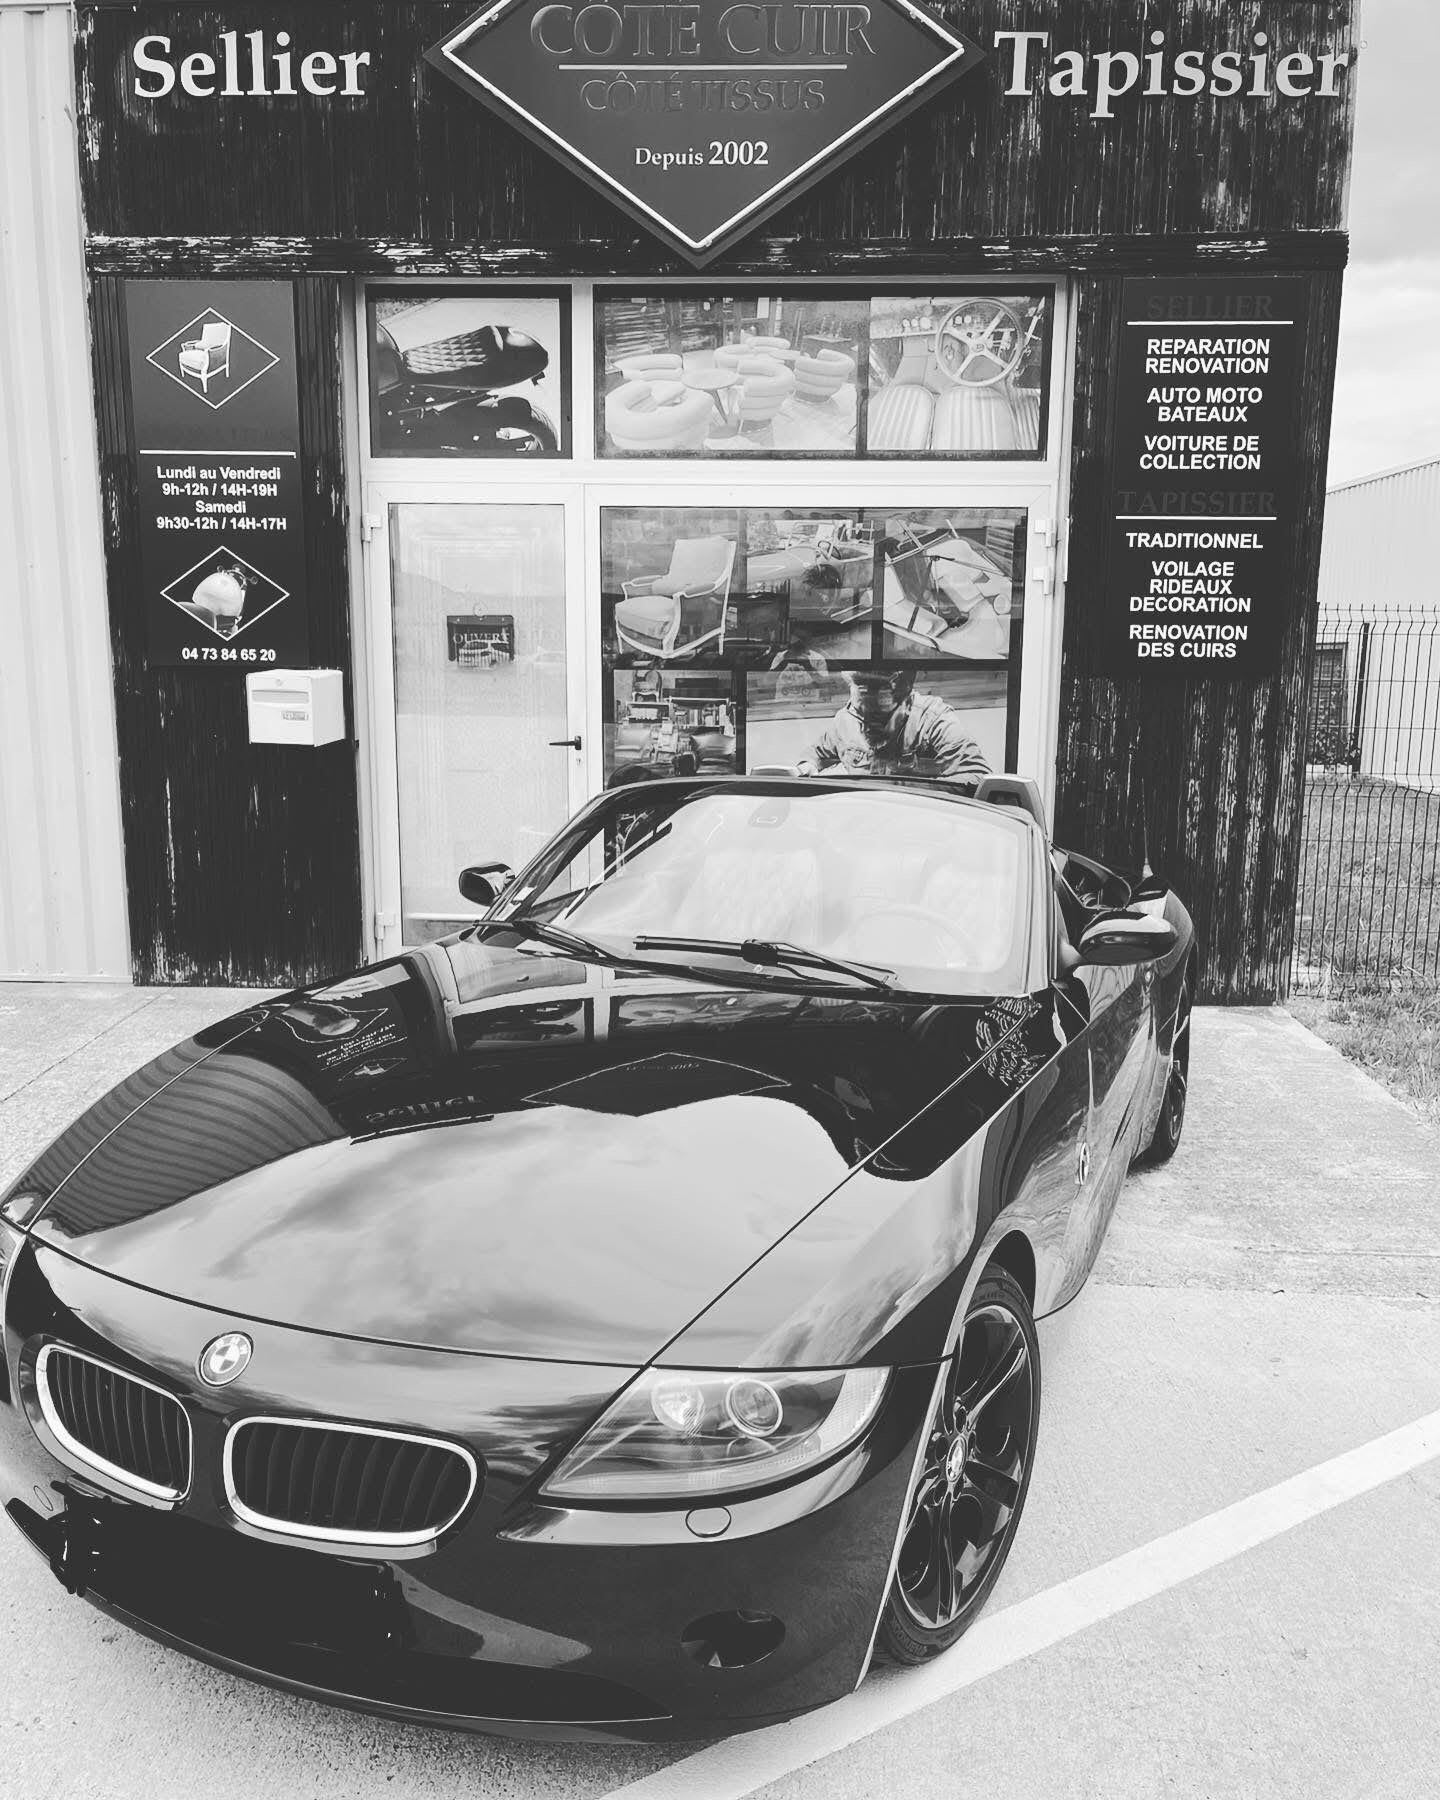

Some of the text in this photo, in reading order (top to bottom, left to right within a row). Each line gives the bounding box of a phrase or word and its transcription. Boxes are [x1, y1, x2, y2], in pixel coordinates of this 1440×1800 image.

[718, 4, 878, 56] CUIR
[132, 29, 371, 98] Sellier
[993, 30, 1348, 118] Tapissier
[580, 71, 825, 112] CÔTÉ TISSUS
[635, 141, 769, 170] Depuis 2002
[1146, 295, 1273, 319] SELLIER
[1146, 338, 1271, 355] REPARATION
[1145, 357, 1270, 374] RENOVATION
[1146, 387, 1263, 404] AUTO MOTO
[1157, 406, 1249, 422] BATEAUX
[1144, 435, 1260, 452] VOITURE DE
[1139, 453, 1262, 470] COLLECTION
[156, 465, 281, 480] Lundi au Vendredi
[161, 483, 209, 496] 9h-12h
[220, 483, 278, 497] 14H-19H
[195, 500, 247, 514] Samedi
[1116, 490, 1276, 514] TAPISSIER
[156, 516, 219, 530] 9h30-12h
[229, 517, 287, 531] 14H-17H
[1125, 532, 1264, 549] TRADITIONNEL
[1151, 560, 1235, 577] VOILAGE
[1149, 578, 1233, 595] RIDEAUX
[1129, 597, 1252, 613] DECORATION
[1129, 624, 1248, 641] RENOVATION
[181, 647, 277, 662] 04 73 84 65 20
[1137, 642, 1237, 659] DES CUIRS
